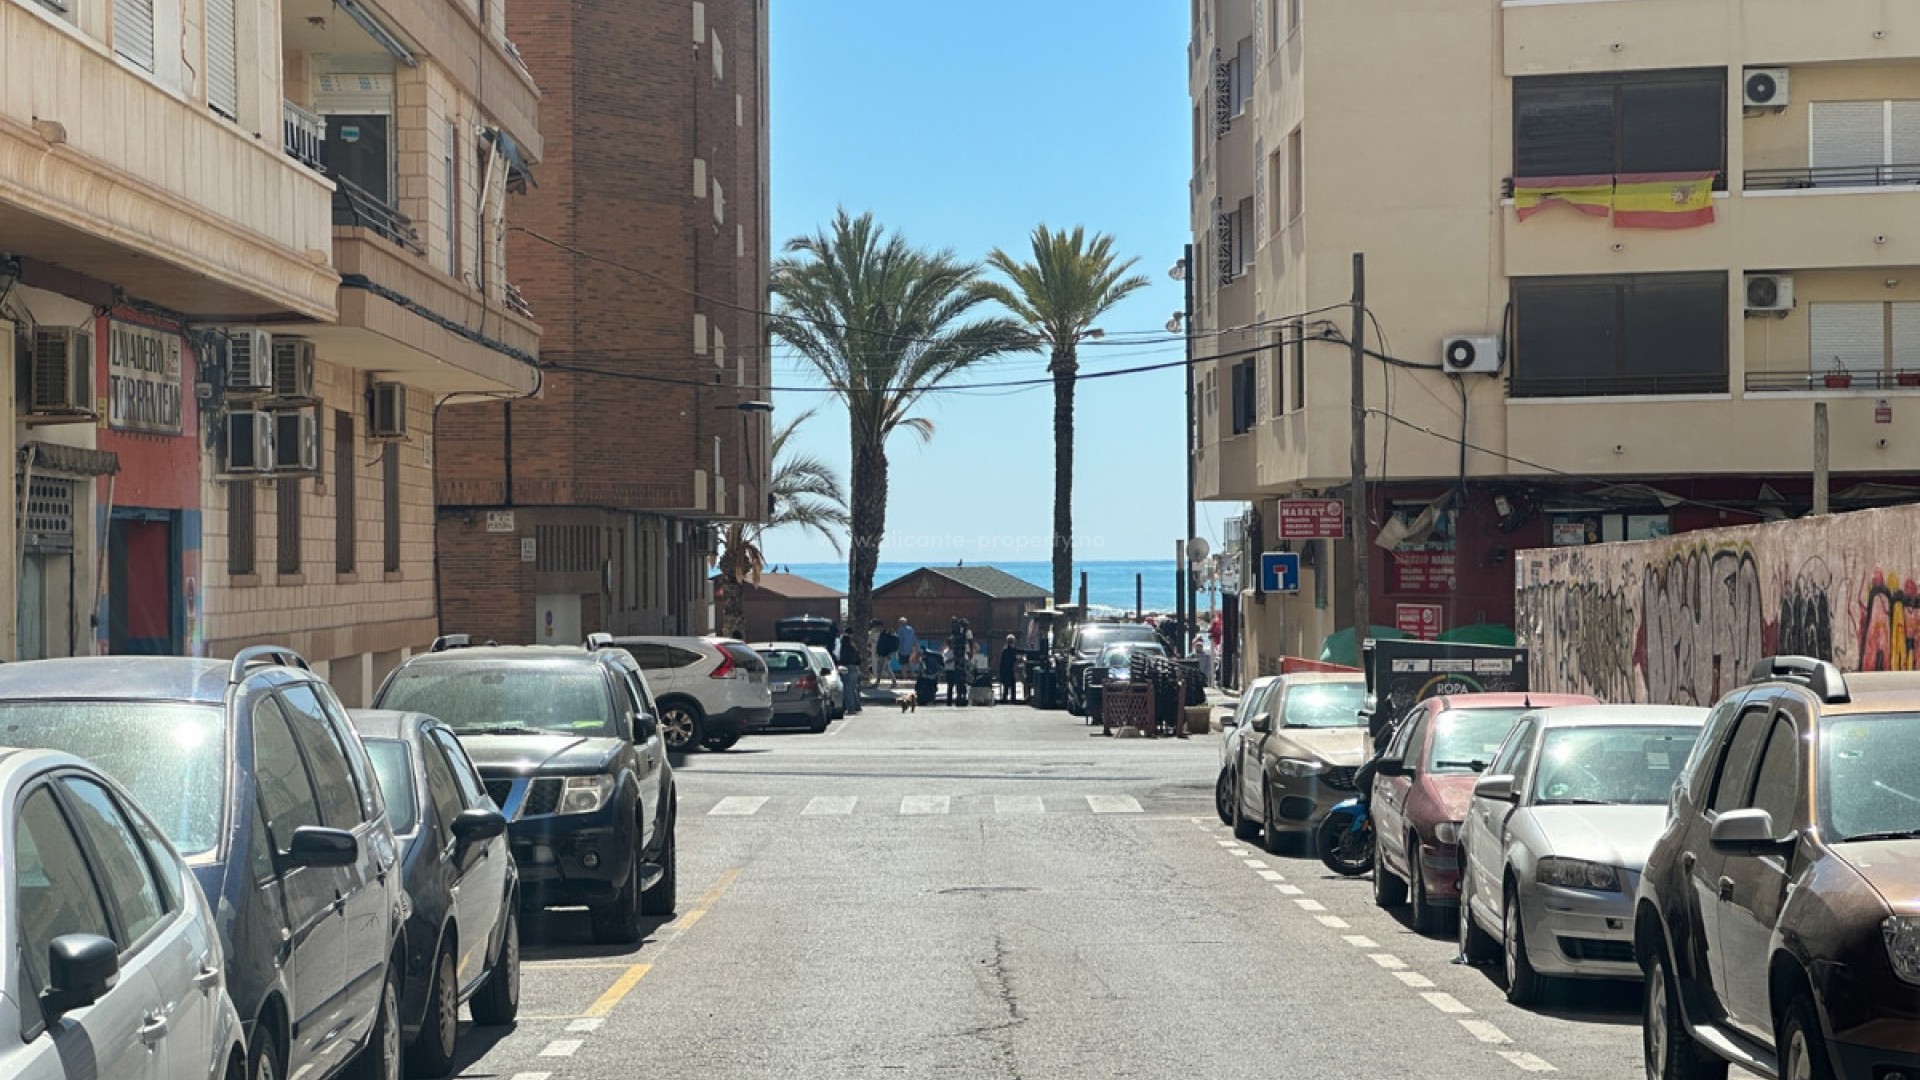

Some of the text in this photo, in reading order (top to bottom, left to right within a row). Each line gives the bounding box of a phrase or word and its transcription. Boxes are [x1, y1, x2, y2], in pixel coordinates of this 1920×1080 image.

[112, 329, 164, 374] LAVADERO
[1282, 507, 1325, 517] MARKET
[1436, 683, 1469, 694] ROPA
